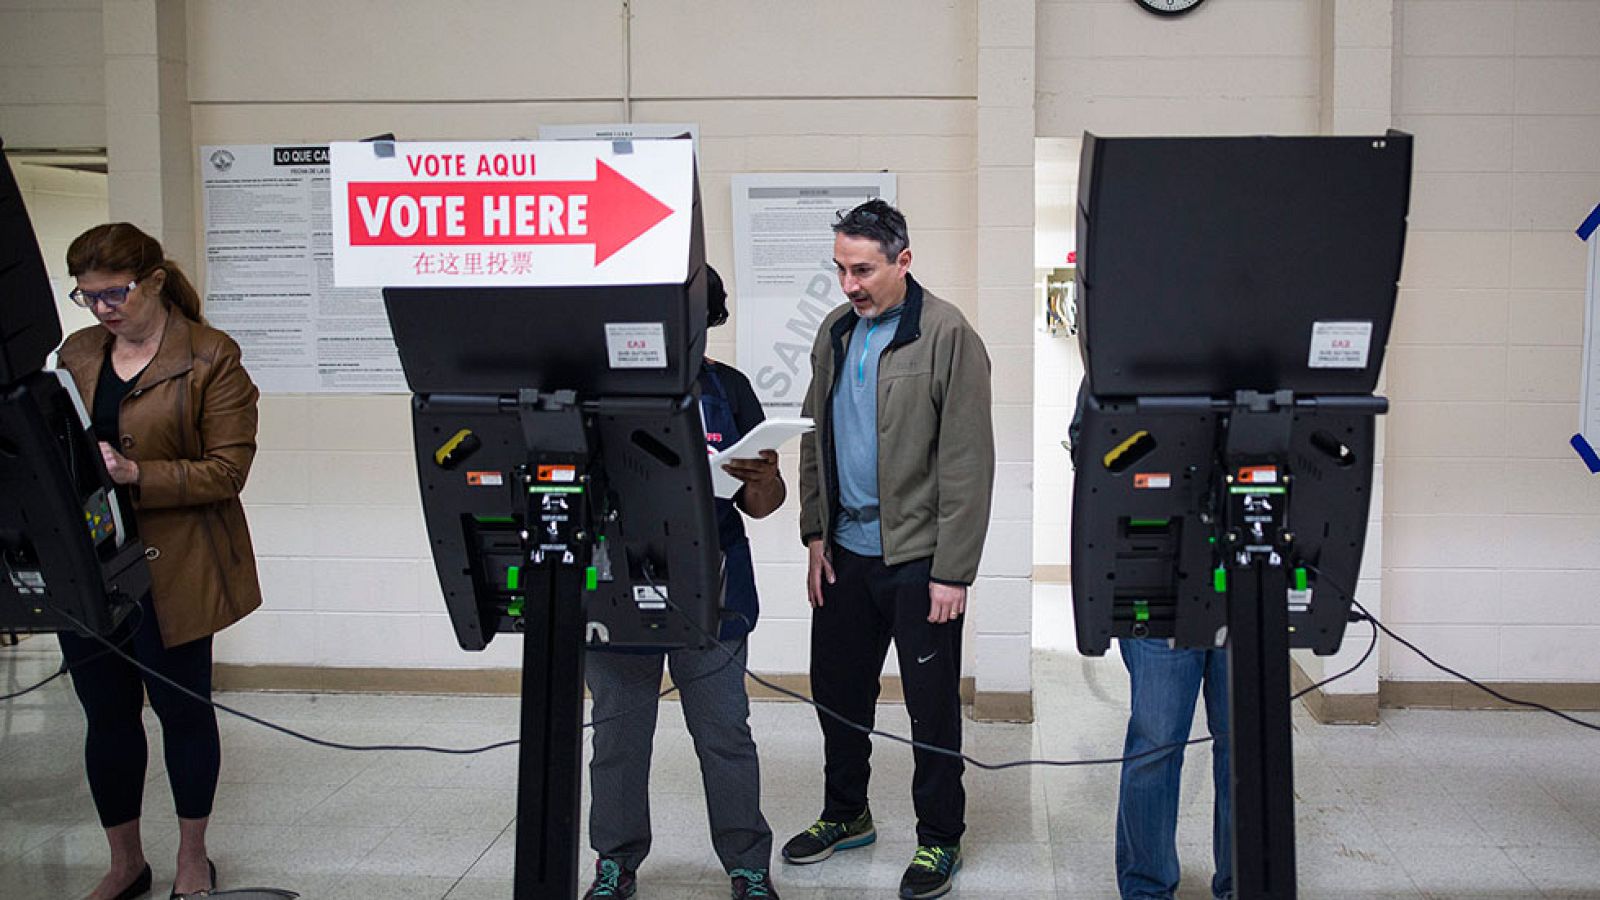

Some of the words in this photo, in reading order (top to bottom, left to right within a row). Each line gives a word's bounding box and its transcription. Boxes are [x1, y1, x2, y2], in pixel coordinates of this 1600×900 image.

[276, 151, 290, 163] LO
[291, 151, 312, 163] QUE
[406, 154, 467, 177] VOTE
[476, 153, 536, 177] AQUI
[356, 195, 466, 238] VOTE
[483, 195, 588, 237] HERE
[412, 251, 533, 276] 在这里投票
[756, 261, 839, 398] SAMP
